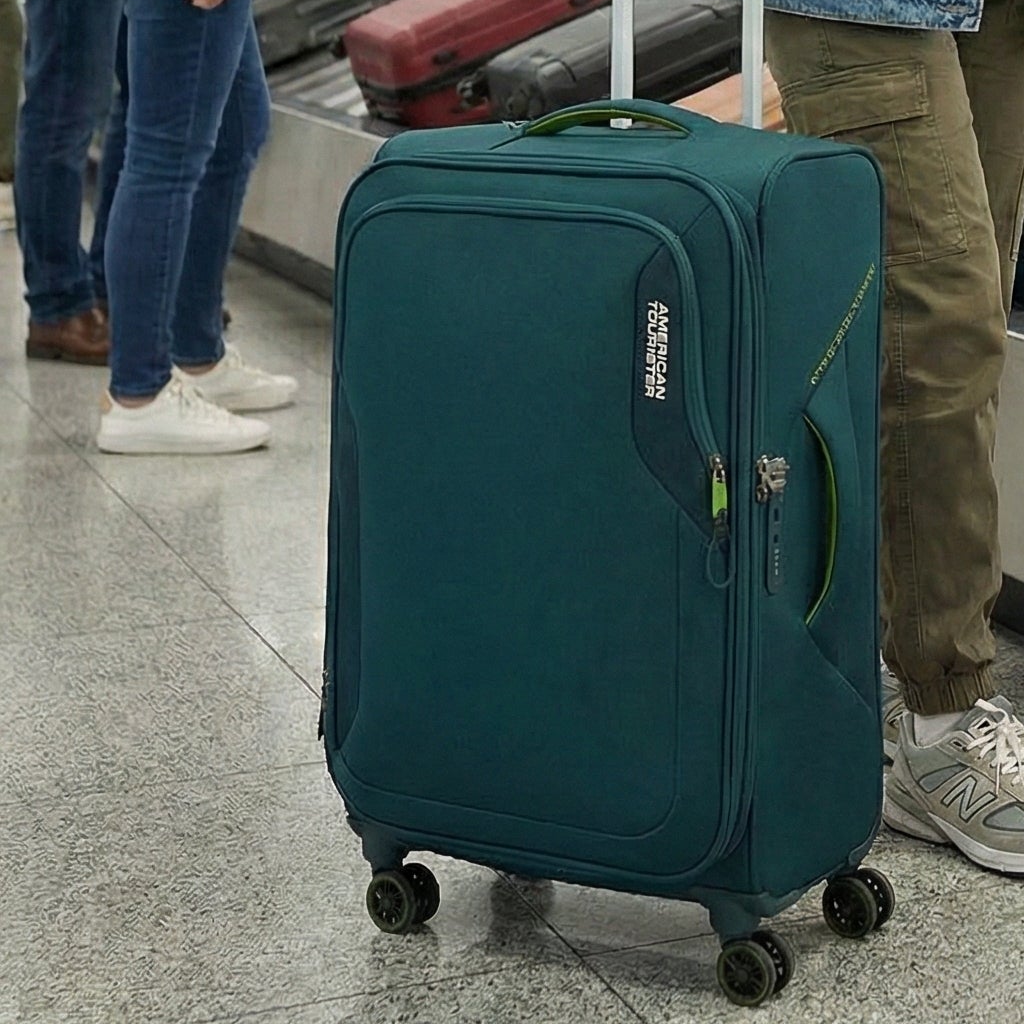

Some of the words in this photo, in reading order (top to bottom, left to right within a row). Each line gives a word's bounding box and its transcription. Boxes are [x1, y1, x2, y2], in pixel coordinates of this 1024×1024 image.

[645, 300, 658, 398] TOURISTER
[656, 302, 669, 400] AMERICAN
[941, 775, 998, 823] N
